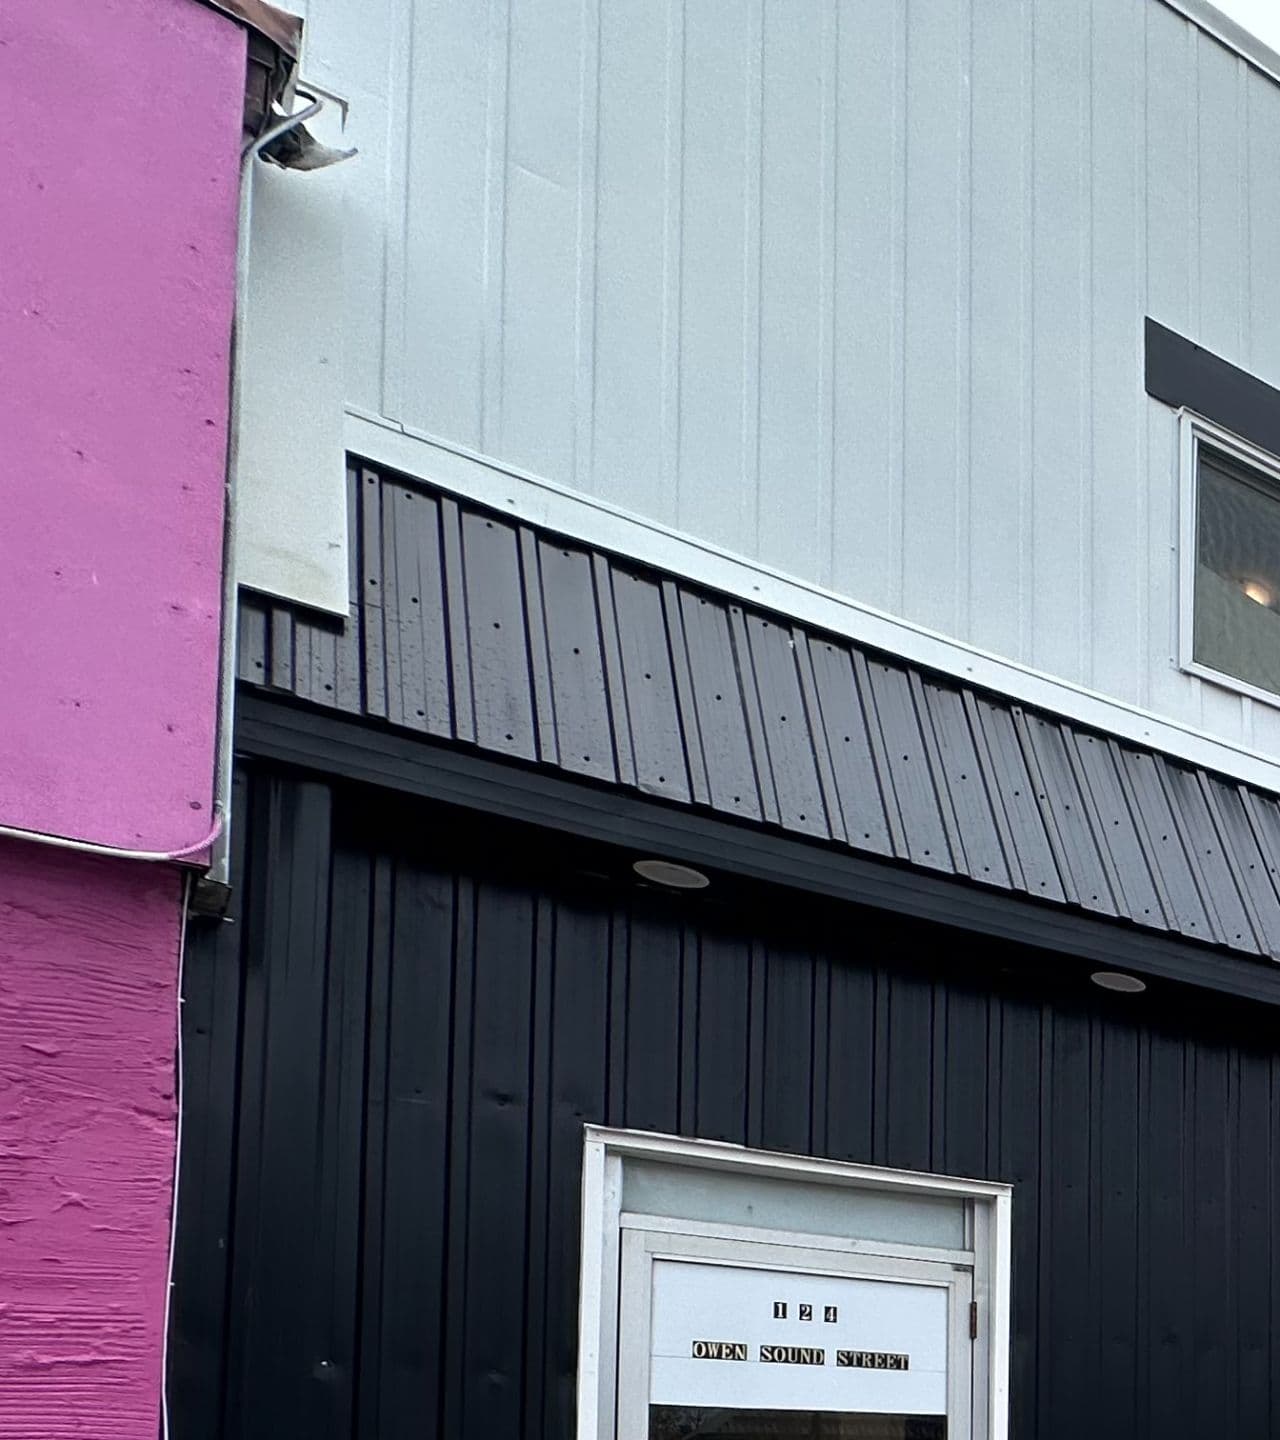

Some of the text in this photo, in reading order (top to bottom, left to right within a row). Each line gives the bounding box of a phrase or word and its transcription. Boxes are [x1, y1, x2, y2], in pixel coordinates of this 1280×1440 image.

[693, 1340, 909, 1370] OWEN SOUND STREET
